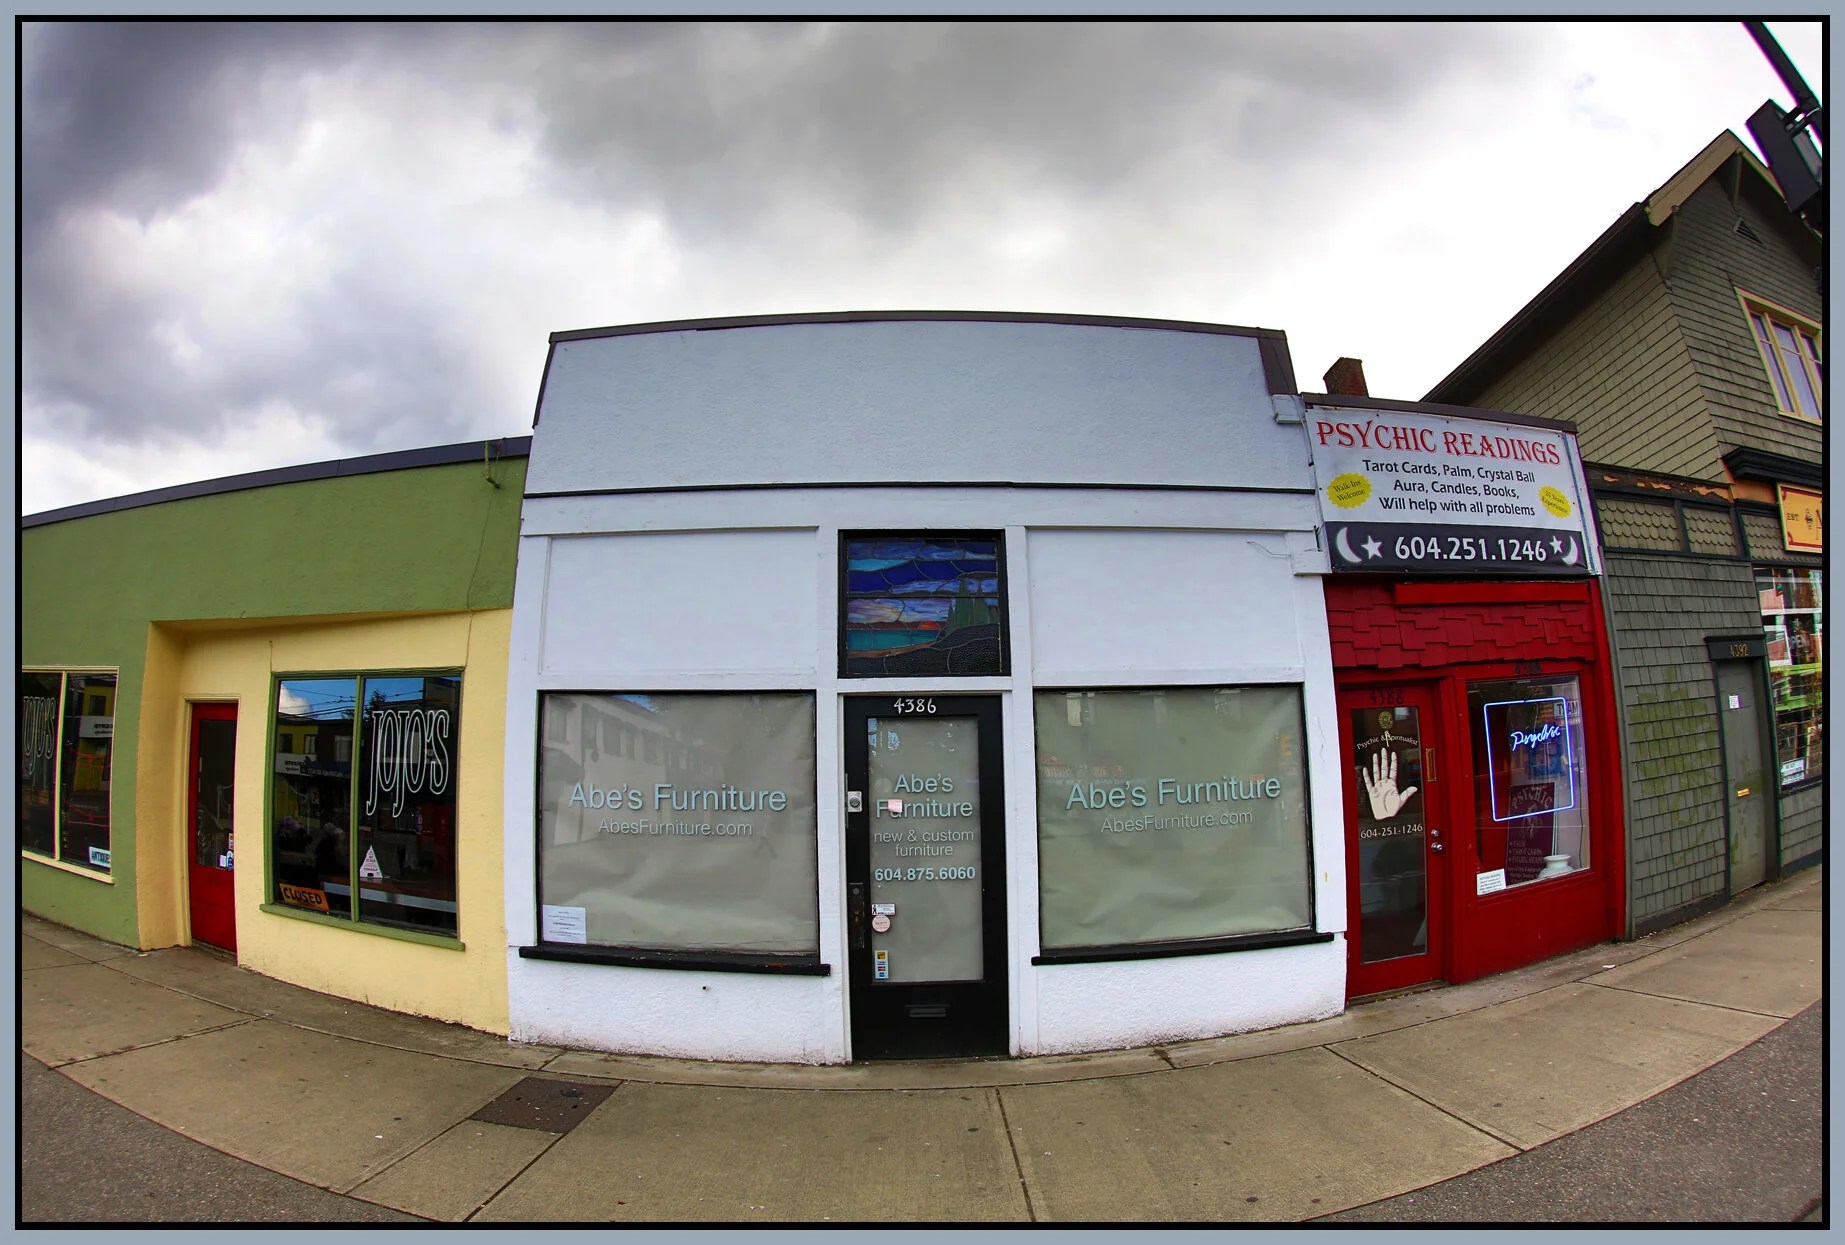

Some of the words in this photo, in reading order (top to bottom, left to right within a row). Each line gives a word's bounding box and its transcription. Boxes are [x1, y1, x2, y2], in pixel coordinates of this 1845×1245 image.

[1316, 420, 1437, 453] PSYCHIC
[1443, 431, 1561, 465] READINGS
[1362, 460, 1399, 473] Tarot
[1402, 461, 1441, 476] Cards,
[1443, 464, 1475, 479] Palm,
[1477, 467, 1514, 482] Crystal
[1516, 470, 1535, 483] Ball
[1333, 480, 1362, 493] Walk-Ins
[1336, 489, 1366, 502] Welcome
[1393, 479, 1429, 494] Aura,
[1431, 481, 1482, 497] Candles,
[1483, 484, 1520, 499] Books,
[1379, 497, 1406, 510] Will
[1409, 498, 1437, 514] help
[1440, 500, 1467, 512] with
[1469, 501, 1484, 513] all
[1486, 503, 1536, 516] problems
[1394, 536, 1548, 562] 604.251.1246
[1729, 643, 1749, 657] 4392
[893, 698, 937, 714] 4386
[1356, 736, 1380, 749] Psychic
[1510, 723, 1561, 752] Psychic
[366, 709, 450, 818] JOJO'S
[894, 774, 954, 793] Abe's
[1065, 780, 1148, 810] Abe's
[1158, 775, 1281, 806] Furniture
[568, 783, 643, 810] Abe's
[654, 783, 787, 811] Furniture
[598, 818, 752, 836] AbesFurniture.com
[1100, 810, 1253, 833] AbesFurniture.com
[874, 832, 903, 842] new
[907, 829, 918, 842] &
[922, 829, 974, 842] custom
[1360, 823, 1423, 839] 604-251-1246
[896, 844, 954, 857] furniture
[875, 866, 976, 881] 604.875.6060
[283, 887, 323, 905] CLOSED
